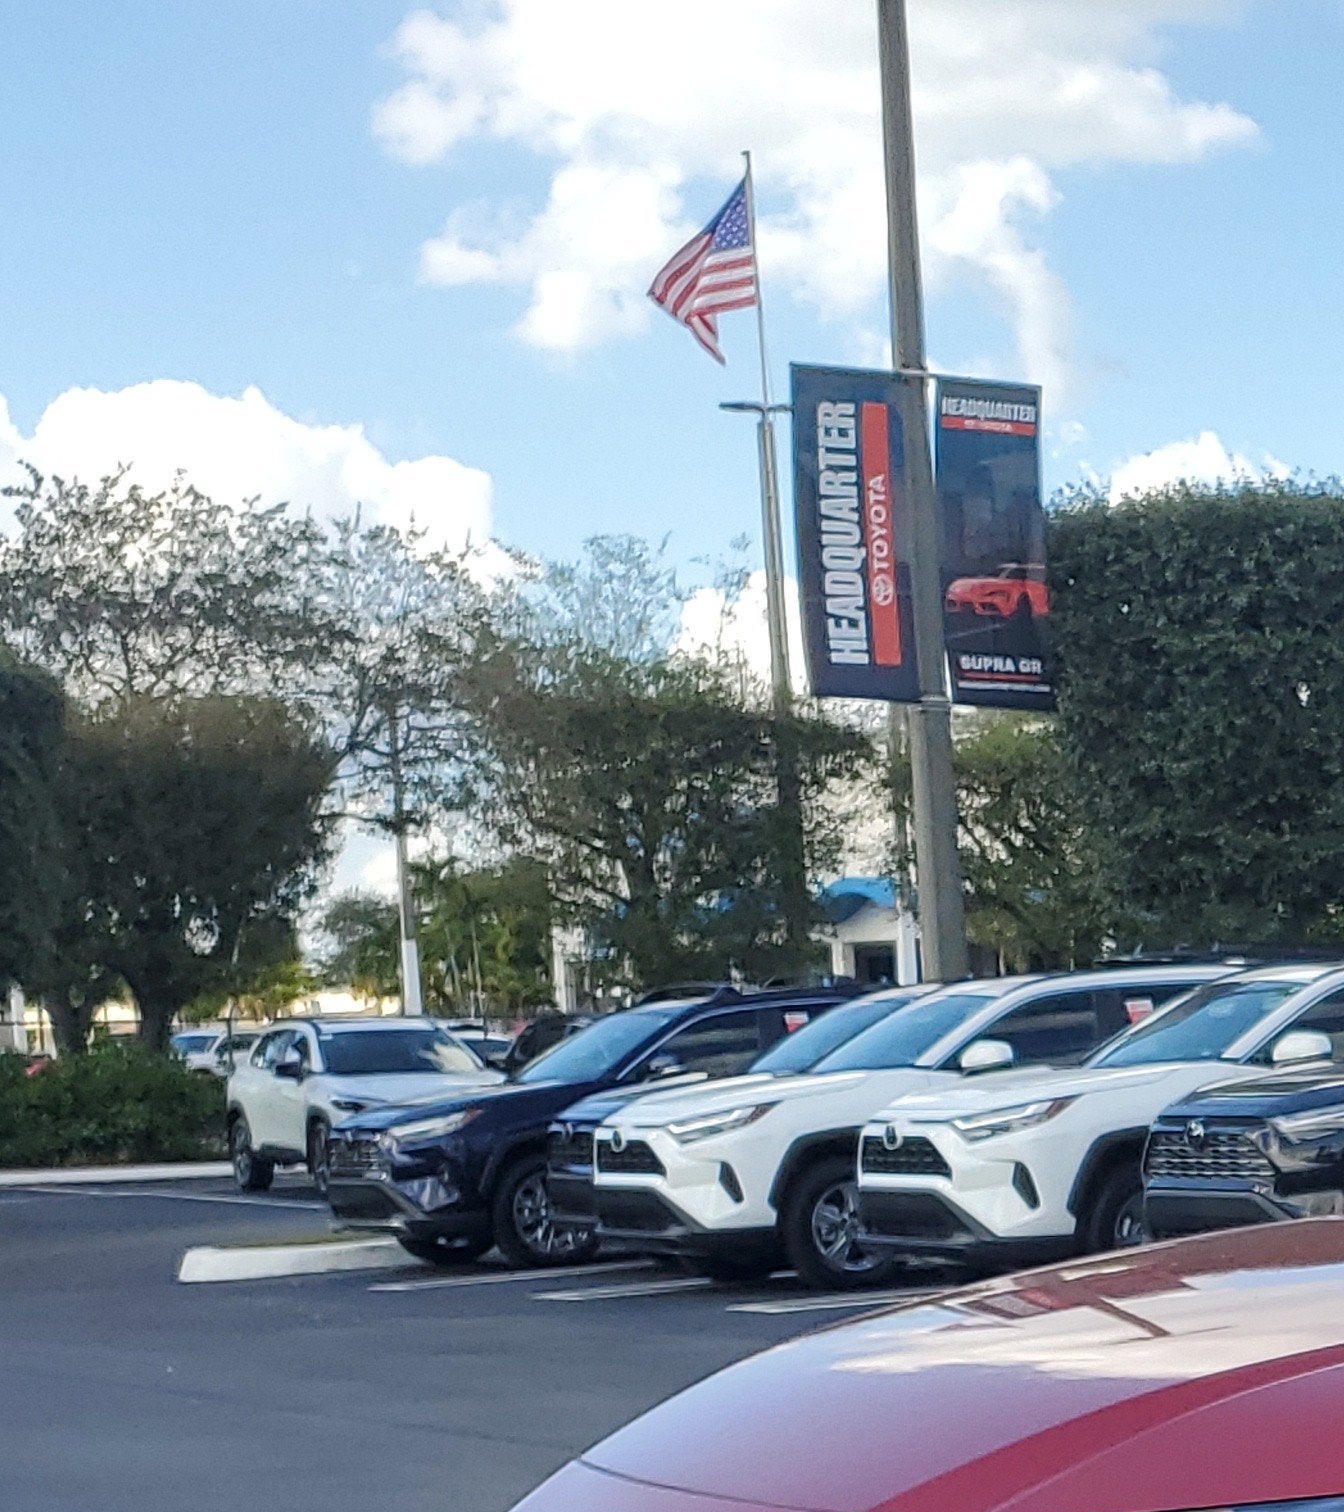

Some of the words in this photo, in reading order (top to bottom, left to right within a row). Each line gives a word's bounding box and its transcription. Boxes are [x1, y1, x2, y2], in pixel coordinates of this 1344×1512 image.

[817, 400, 870, 666] HEADQUARTER
[869, 474, 892, 574] TOYOTA
[960, 655, 1016, 673] SUPRA
